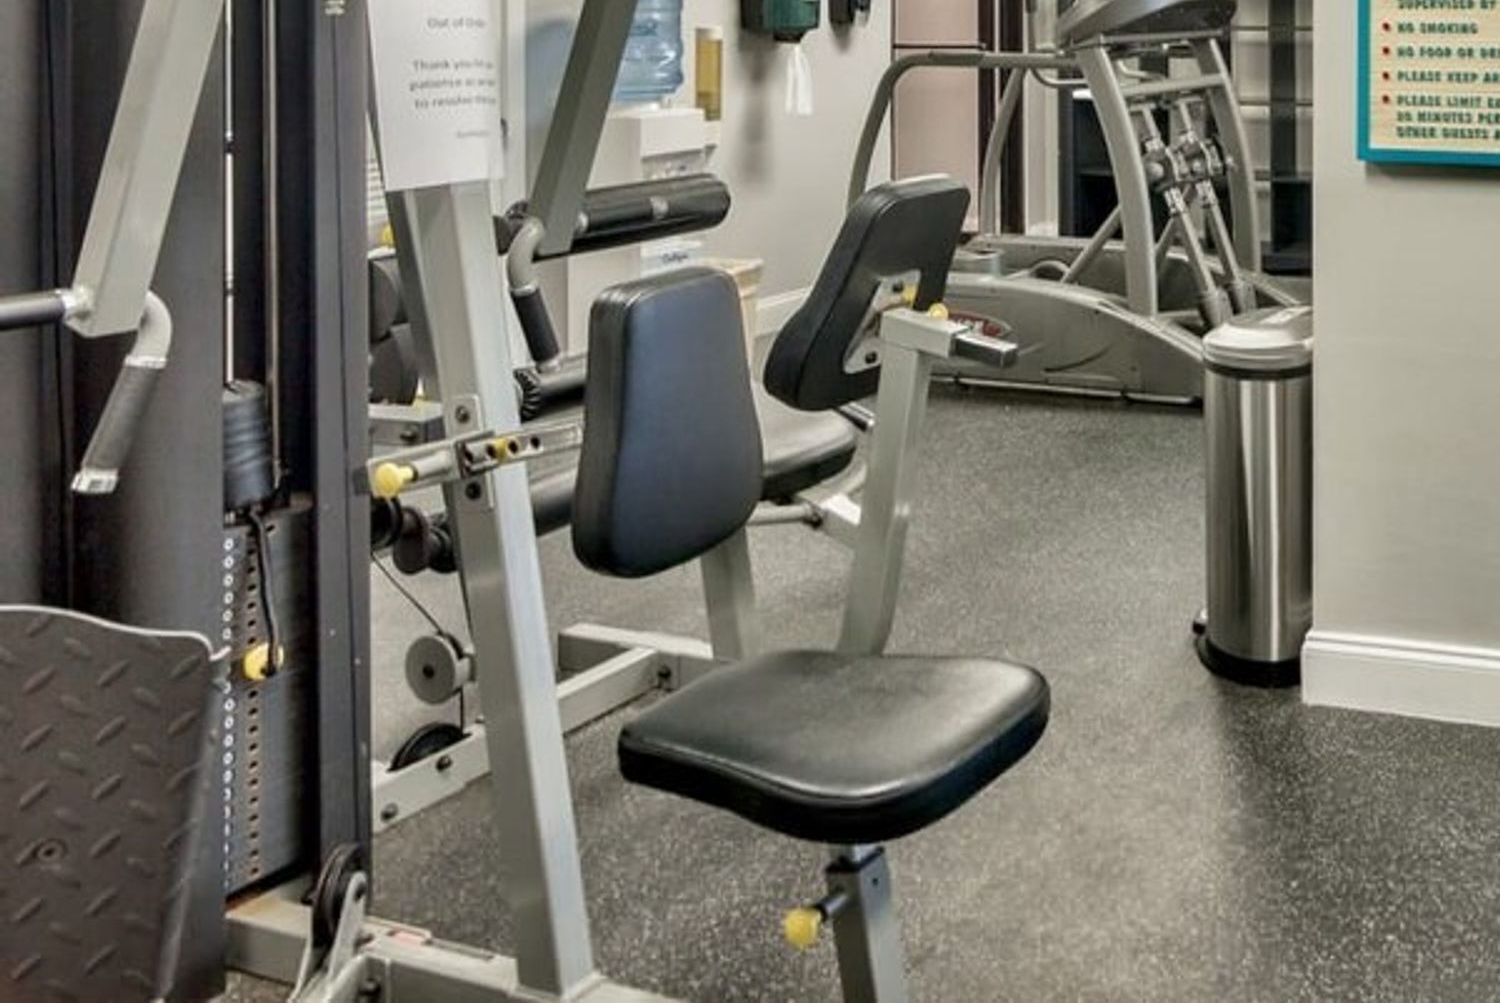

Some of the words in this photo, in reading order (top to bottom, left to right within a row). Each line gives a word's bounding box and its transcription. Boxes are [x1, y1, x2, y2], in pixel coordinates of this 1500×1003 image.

[1398, 22, 1414, 34] NO
[1420, 22, 1479, 35] SMOKING
[1398, 46, 1414, 58] NO
[1420, 46, 1452, 58] FOOD
[1457, 47, 1475, 58] OR
[1397, 71, 1442, 82] PLEASE
[1447, 72, 1479, 84] KEEP
[1397, 95, 1442, 107] PLEASE
[1447, 96, 1481, 108] LIMIT
[1418, 112, 1472, 124] MINUTES
[1397, 126, 1437, 138] OTHER
[1442, 128, 1489, 139] GUESTS
